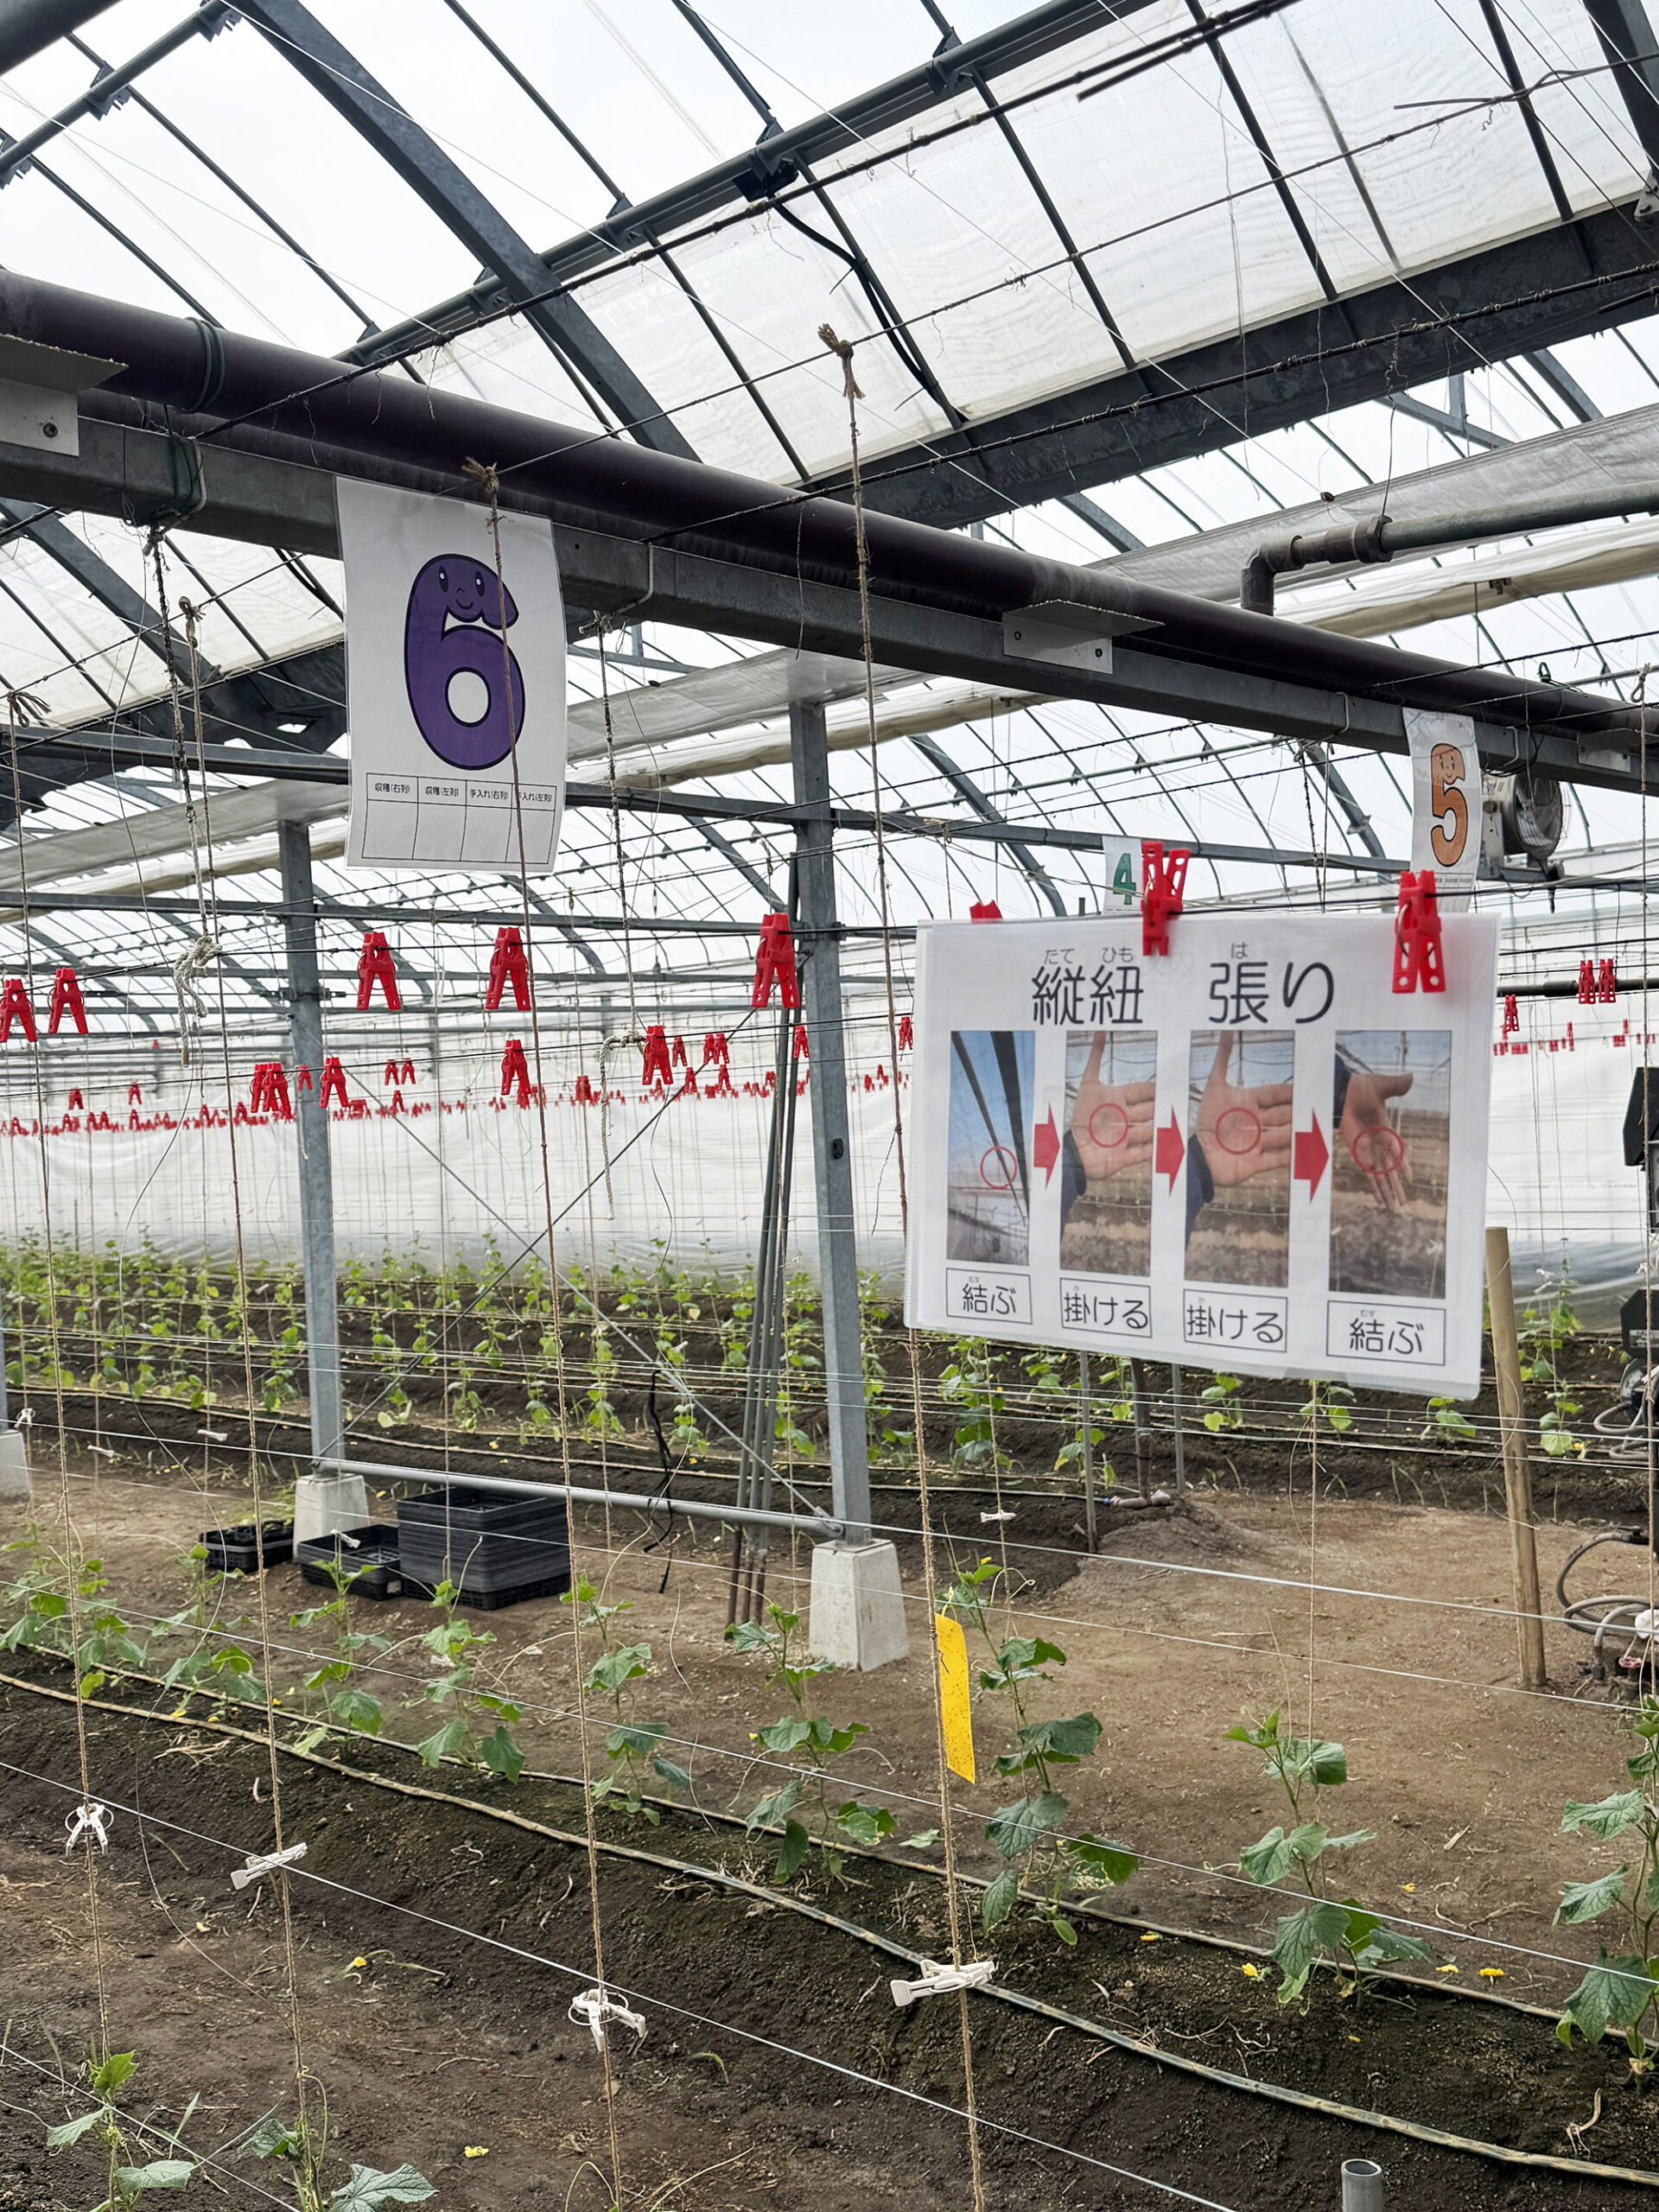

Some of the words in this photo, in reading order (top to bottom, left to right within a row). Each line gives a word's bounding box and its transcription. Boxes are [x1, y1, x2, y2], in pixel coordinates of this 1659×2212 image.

[404, 554, 525, 771] 6
[1431, 743, 1468, 867] 5
[1113, 853, 1136, 905] 4
[1044, 949, 1075, 964] たて
[1102, 947, 1134, 963] ひも
[1230, 942, 1249, 959] は
[1032, 965, 1144, 1026] 縦紐
[1209, 961, 1334, 1025] 張り
[962, 1283, 1016, 1315] 結ぶ
[1064, 1292, 1148, 1330] 掛ける
[1186, 1304, 1283, 1344] 掛ける
[1350, 1317, 1424, 1355] 結ぶ
